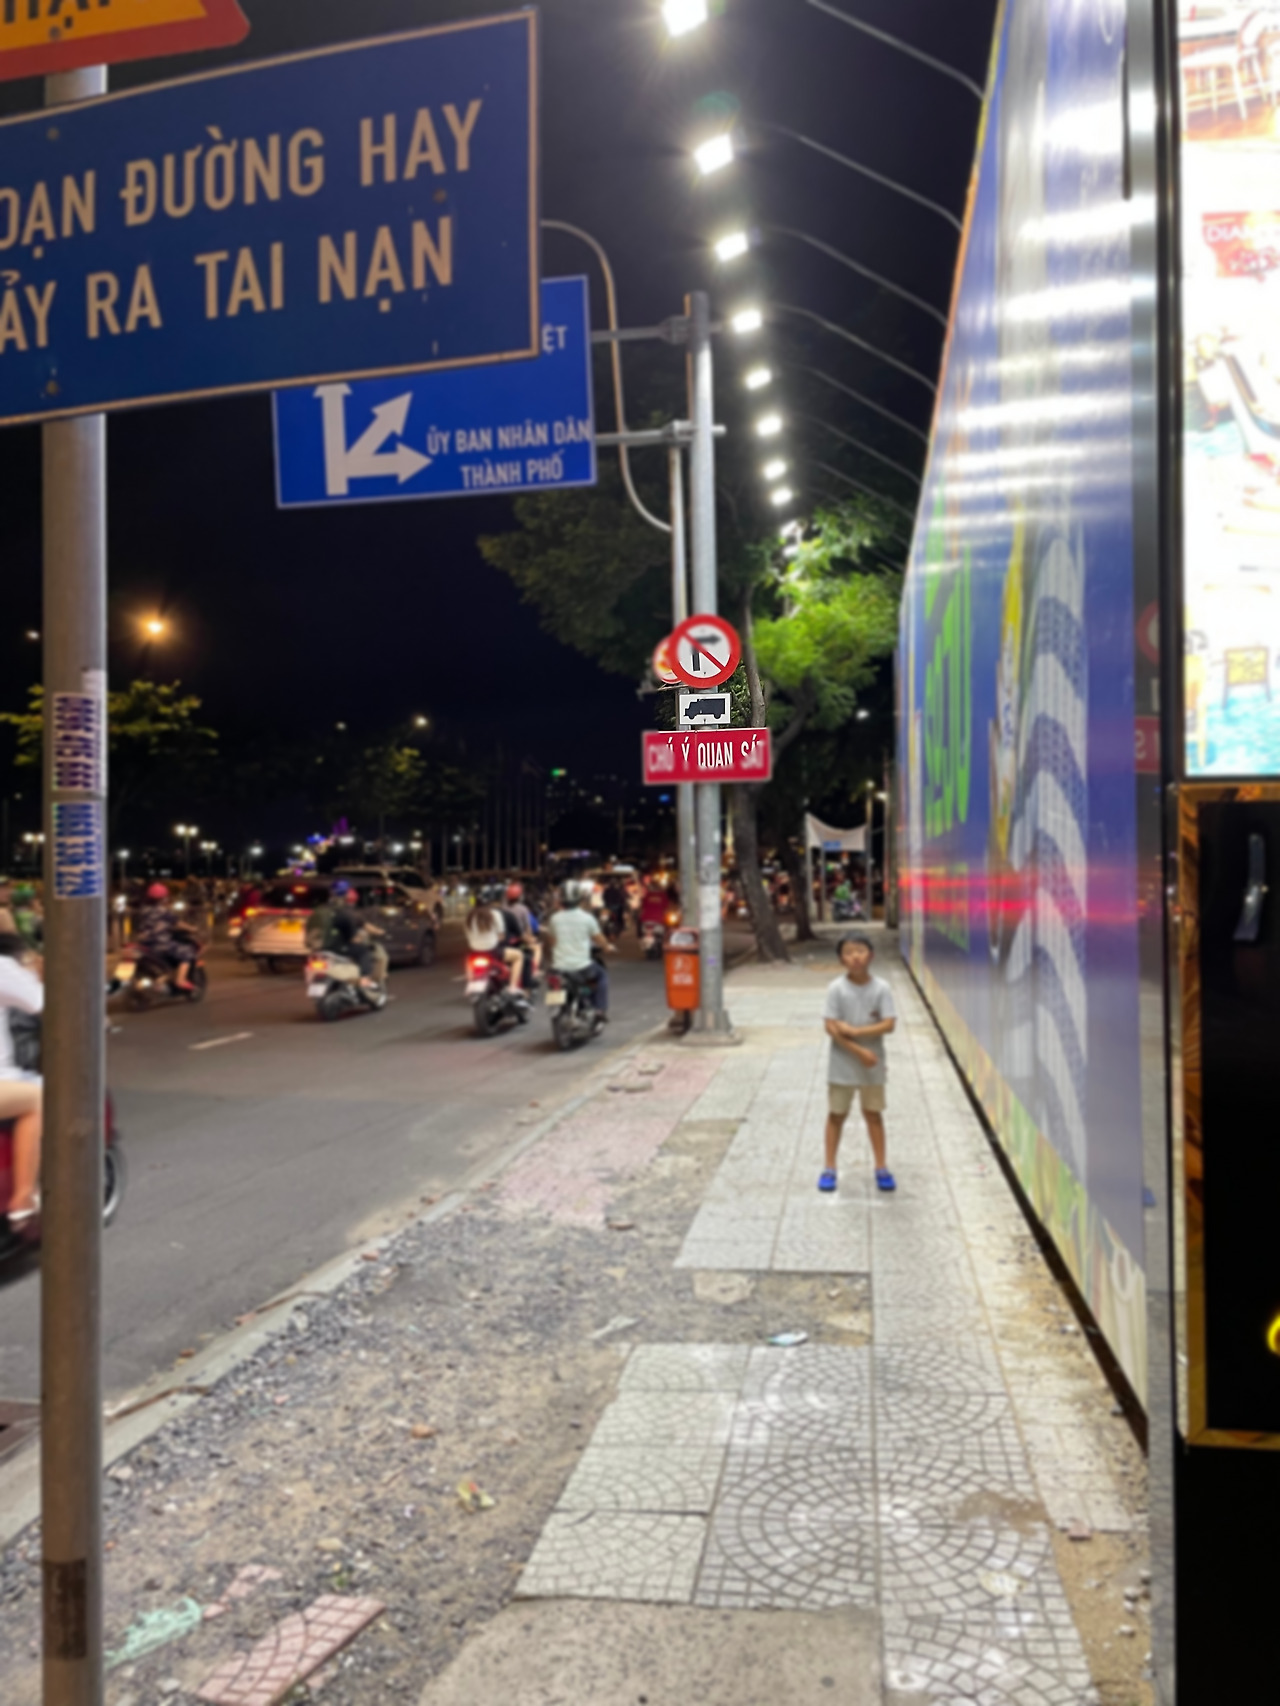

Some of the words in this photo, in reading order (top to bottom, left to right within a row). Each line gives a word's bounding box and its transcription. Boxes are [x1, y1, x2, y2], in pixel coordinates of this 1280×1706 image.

[120, 126, 324, 226] ĐƯỜNG
[360, 99, 482, 186] HAY
[87, 264, 162, 338] RA
[195, 242, 283, 319] TAI
[319, 216, 452, 312] NẠN
[455, 428, 492, 453] BAN
[498, 418, 548, 449] NHÂN
[553, 415, 591, 445] DÂN
[460, 457, 522, 488] THÀNH
[526, 448, 565, 482] PHỐ
[681, 736, 690, 771] Ý
[697, 741, 733, 770] QUAN
